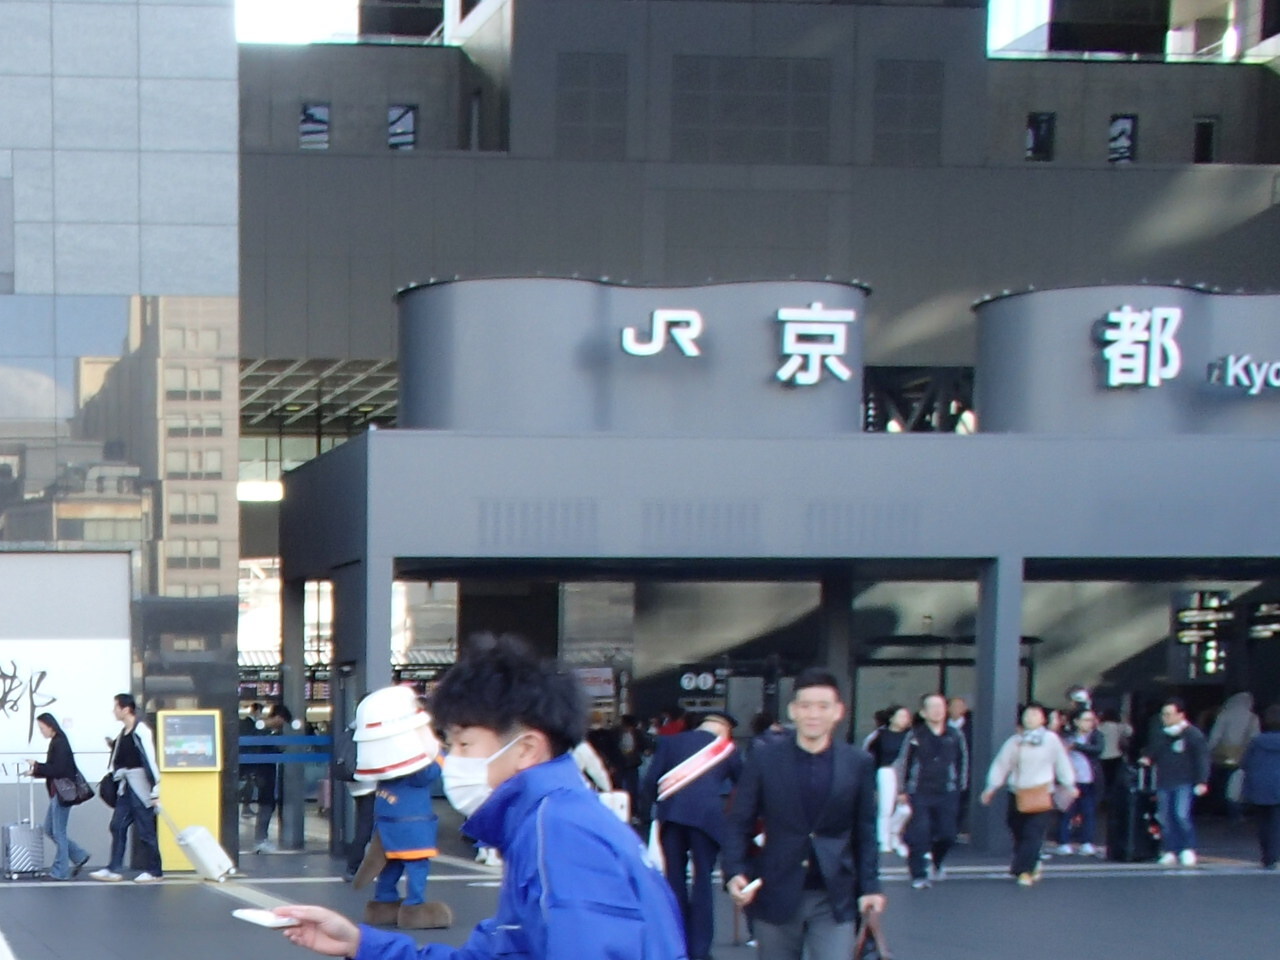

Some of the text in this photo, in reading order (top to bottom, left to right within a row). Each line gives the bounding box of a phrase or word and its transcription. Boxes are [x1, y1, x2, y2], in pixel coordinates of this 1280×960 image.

[621, 308, 702, 358] JR
[776, 301, 1182, 388] 京 都
